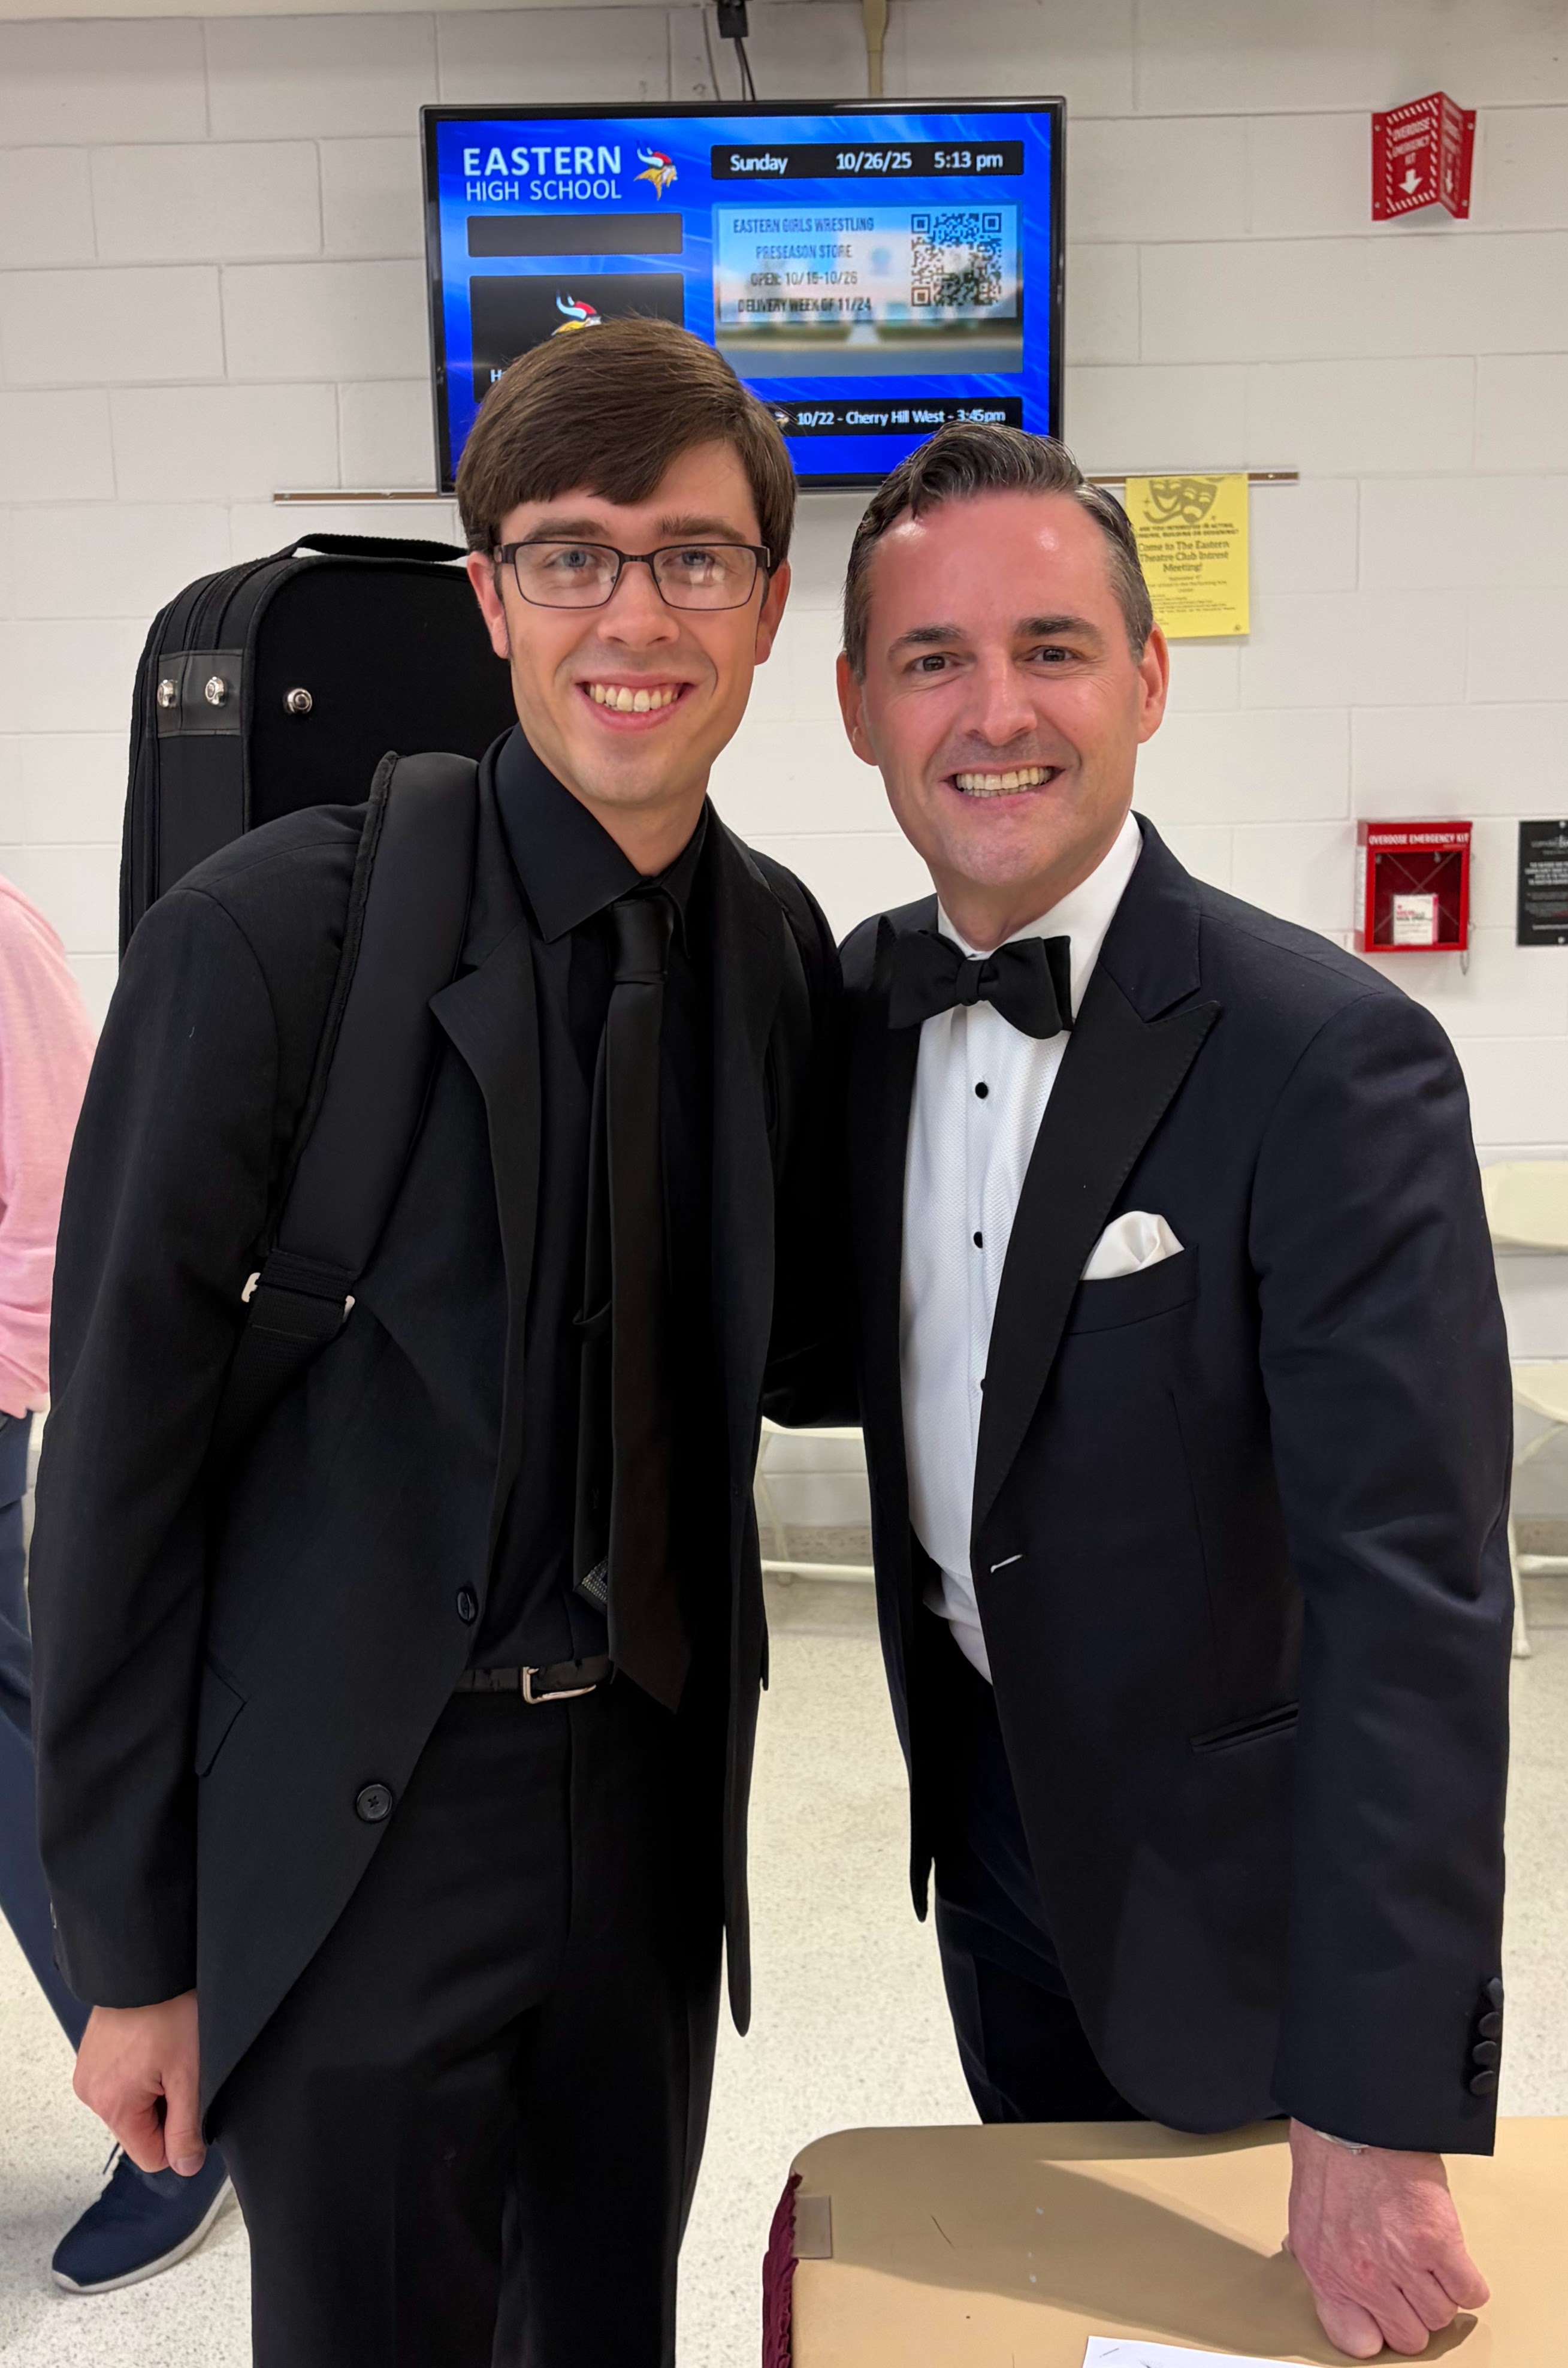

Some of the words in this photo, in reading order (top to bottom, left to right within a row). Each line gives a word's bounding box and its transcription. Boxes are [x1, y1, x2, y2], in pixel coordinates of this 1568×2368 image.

[463, 146, 621, 176] EASTERN
[730, 153, 788, 174] Sunday
[836, 152, 913, 173] 10/26/25
[934, 151, 971, 168] 5:13
[976, 154, 1004, 172] pm
[466, 181, 519, 202] HIGH
[530, 179, 622, 201] SCHOOL
[733, 219, 780, 233] EASTERN
[783, 218, 812, 233] GIRLS
[814, 217, 874, 233] WRESTLING
[756, 245, 817, 260] PRESEASON
[818, 244, 852, 259] STORE
[738, 298, 785, 313] DELIVERY
[788, 298, 819, 312] WEEK
[821, 298, 833, 312] OF
[838, 297, 872, 312] 11/24
[797, 411, 835, 427] 10/22
[845, 411, 889, 427] Cherry
[891, 410, 910, 423] Hill
[911, 409, 945, 423] West
[1368, 834, 1407, 845] OVERDOSE
[1409, 832, 1455, 844] EMERGENCY
[1457, 832, 1469, 843] KIT
